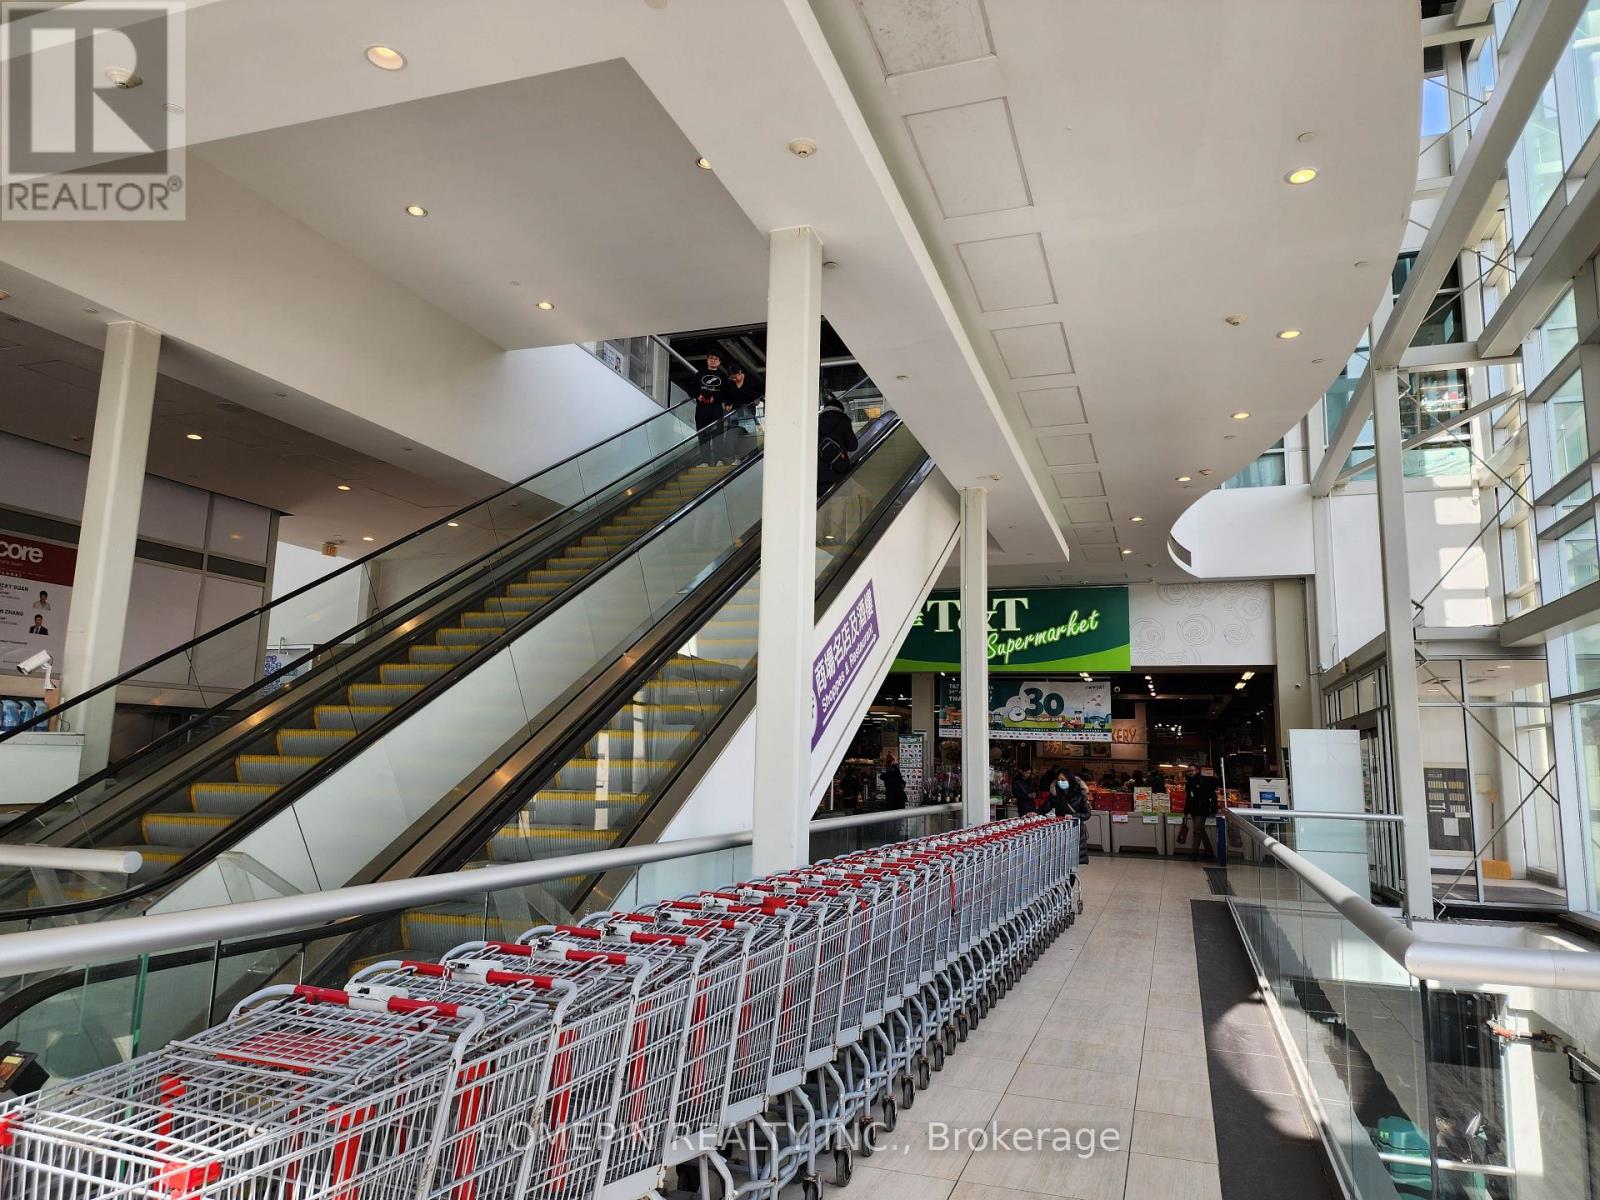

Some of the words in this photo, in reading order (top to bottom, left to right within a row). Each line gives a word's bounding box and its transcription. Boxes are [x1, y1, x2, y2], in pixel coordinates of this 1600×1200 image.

[987, 609, 1101, 665] Supermarket
[821, 670, 845, 713] Shoppes
[844, 660, 850, 676] &
[849, 623, 874, 668] Restaurant
[1023, 687, 1065, 717] 30
